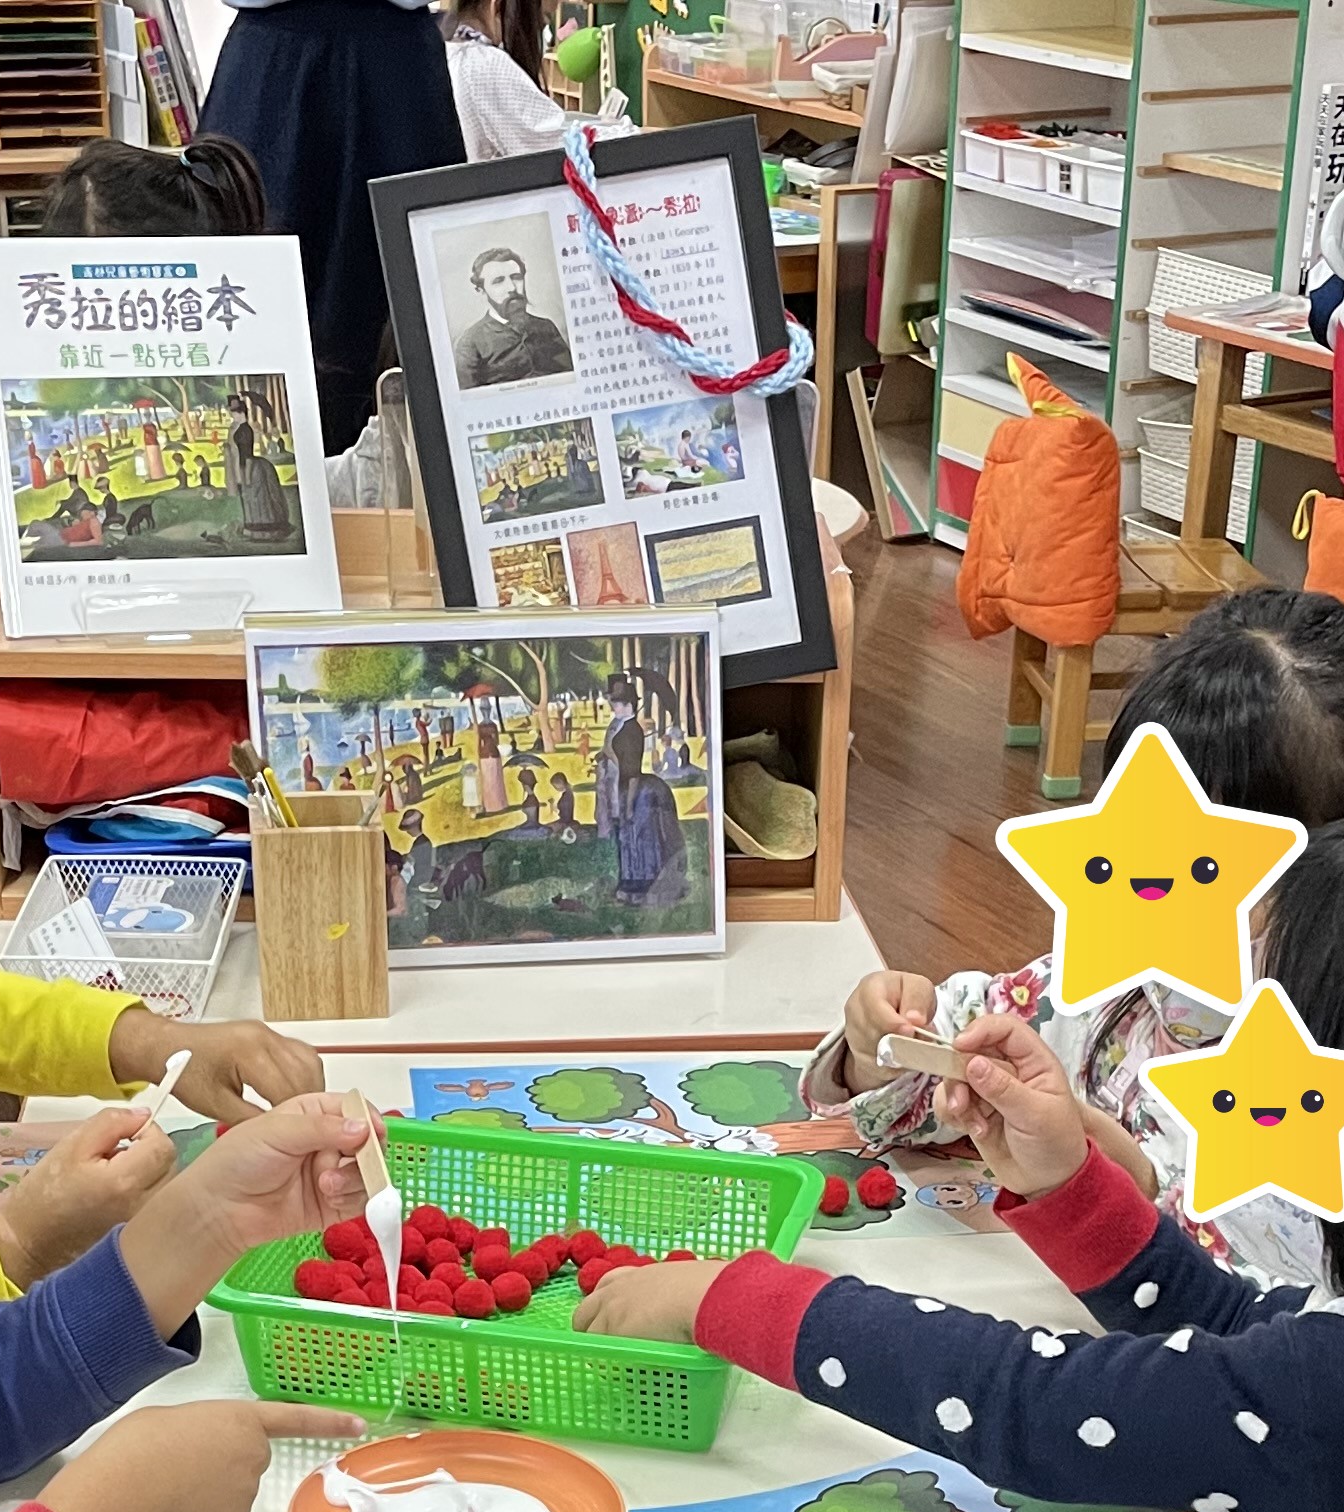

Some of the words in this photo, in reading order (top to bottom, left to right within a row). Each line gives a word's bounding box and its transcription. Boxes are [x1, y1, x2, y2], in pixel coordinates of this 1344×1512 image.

[17, 272, 256, 332] 秀拉的繪本
[59, 342, 229, 369] 靠近一點兒看！
